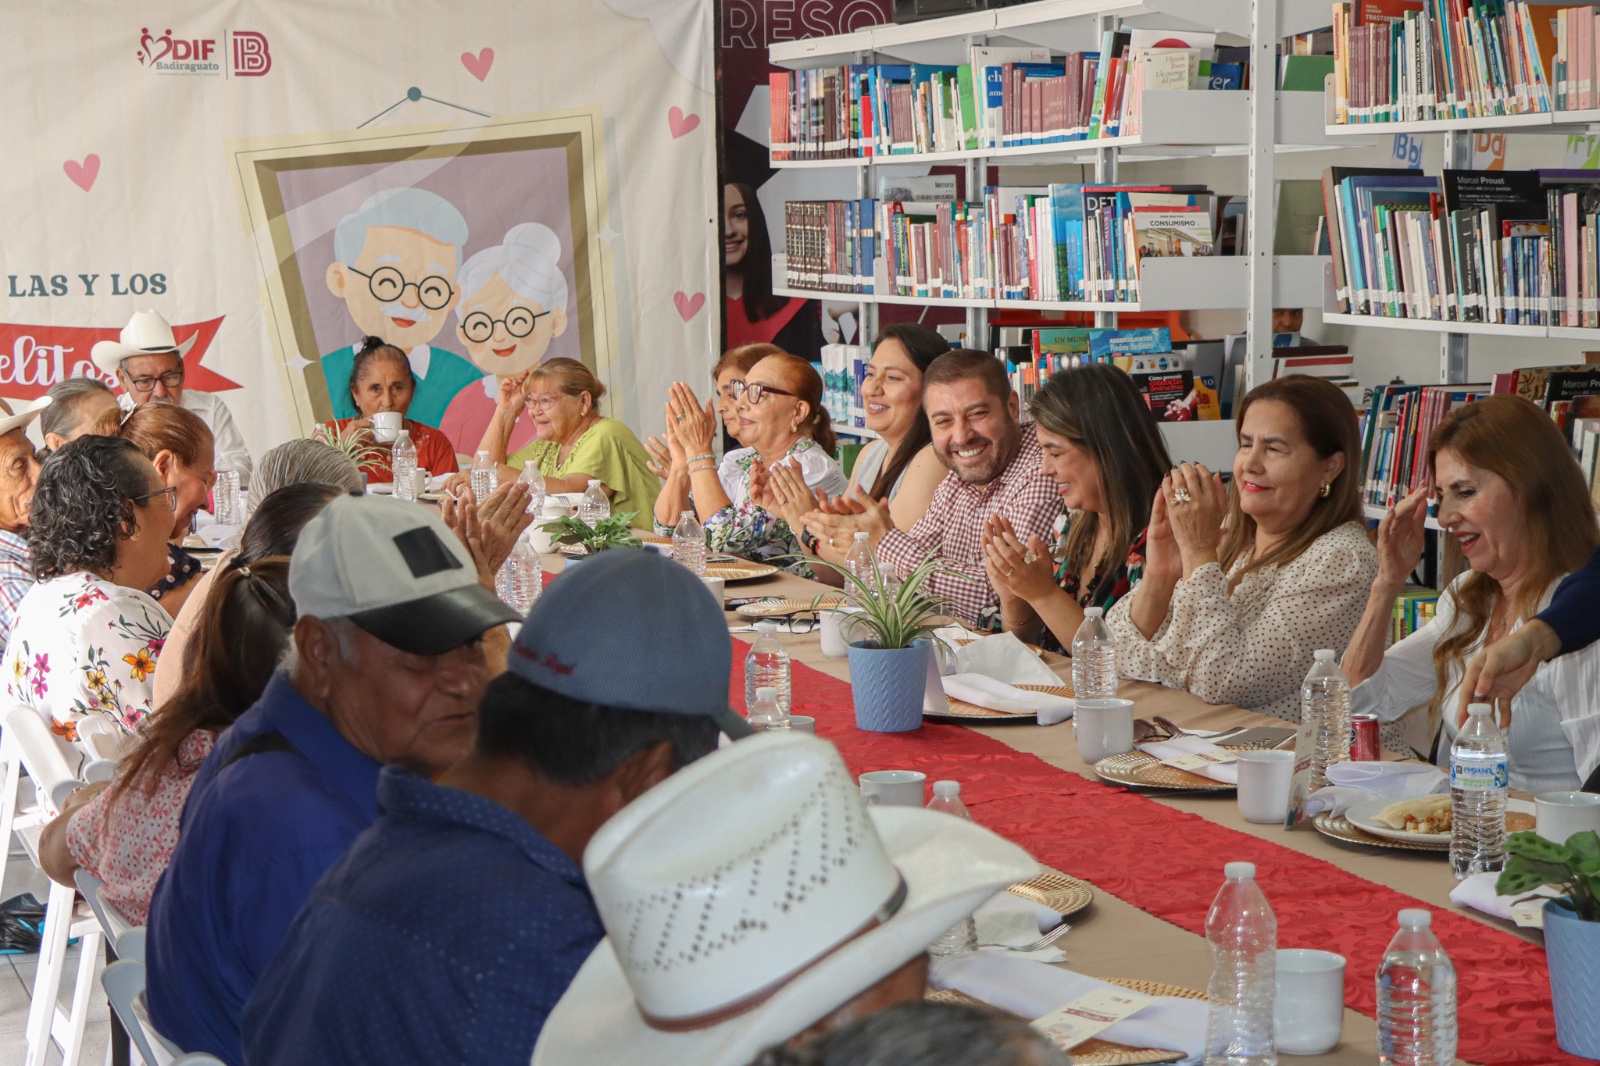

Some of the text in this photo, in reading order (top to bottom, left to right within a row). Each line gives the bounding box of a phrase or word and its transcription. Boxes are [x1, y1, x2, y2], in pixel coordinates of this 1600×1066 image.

[172, 40, 216, 61] DIF
[156, 60, 219, 72] Badiraguato
[1457, 176, 1505, 185] Marcel Proust
[8, 273, 167, 297] LAS Y LOS
[1110, 343, 1129, 351] Redes
[1562, 380, 1588, 388] Marcel
